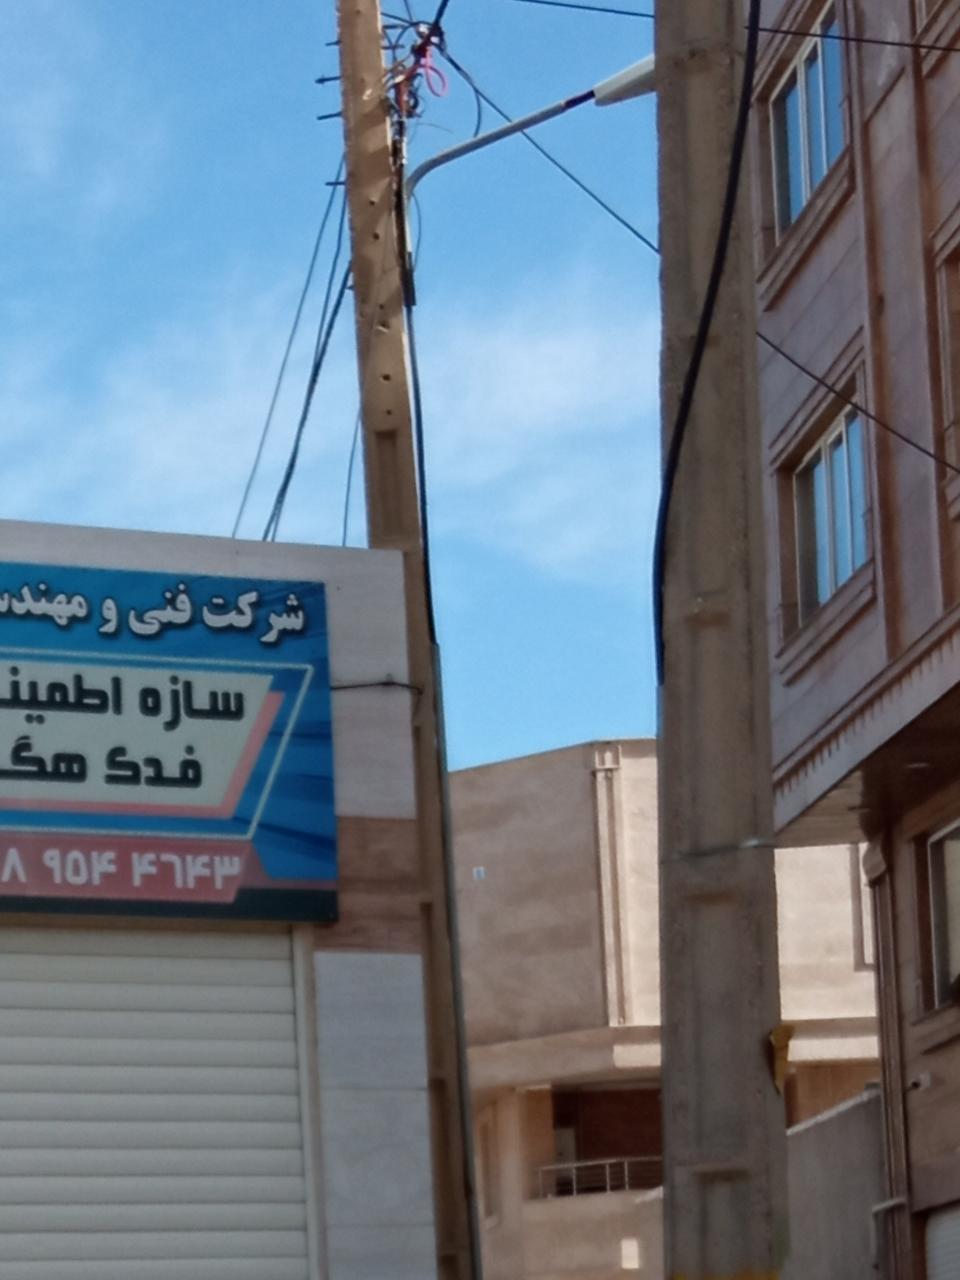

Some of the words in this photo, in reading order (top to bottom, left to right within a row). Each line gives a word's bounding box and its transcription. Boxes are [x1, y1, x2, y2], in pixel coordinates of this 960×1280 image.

[99, 598, 119, 634] و
[128, 583, 193, 634] فنی
[202, 591, 305, 643] شرکت
[139, 675, 245, 731] سازه
[104, 744, 203, 789] فدک
[43, 849, 117, 886] ۹۵۴
